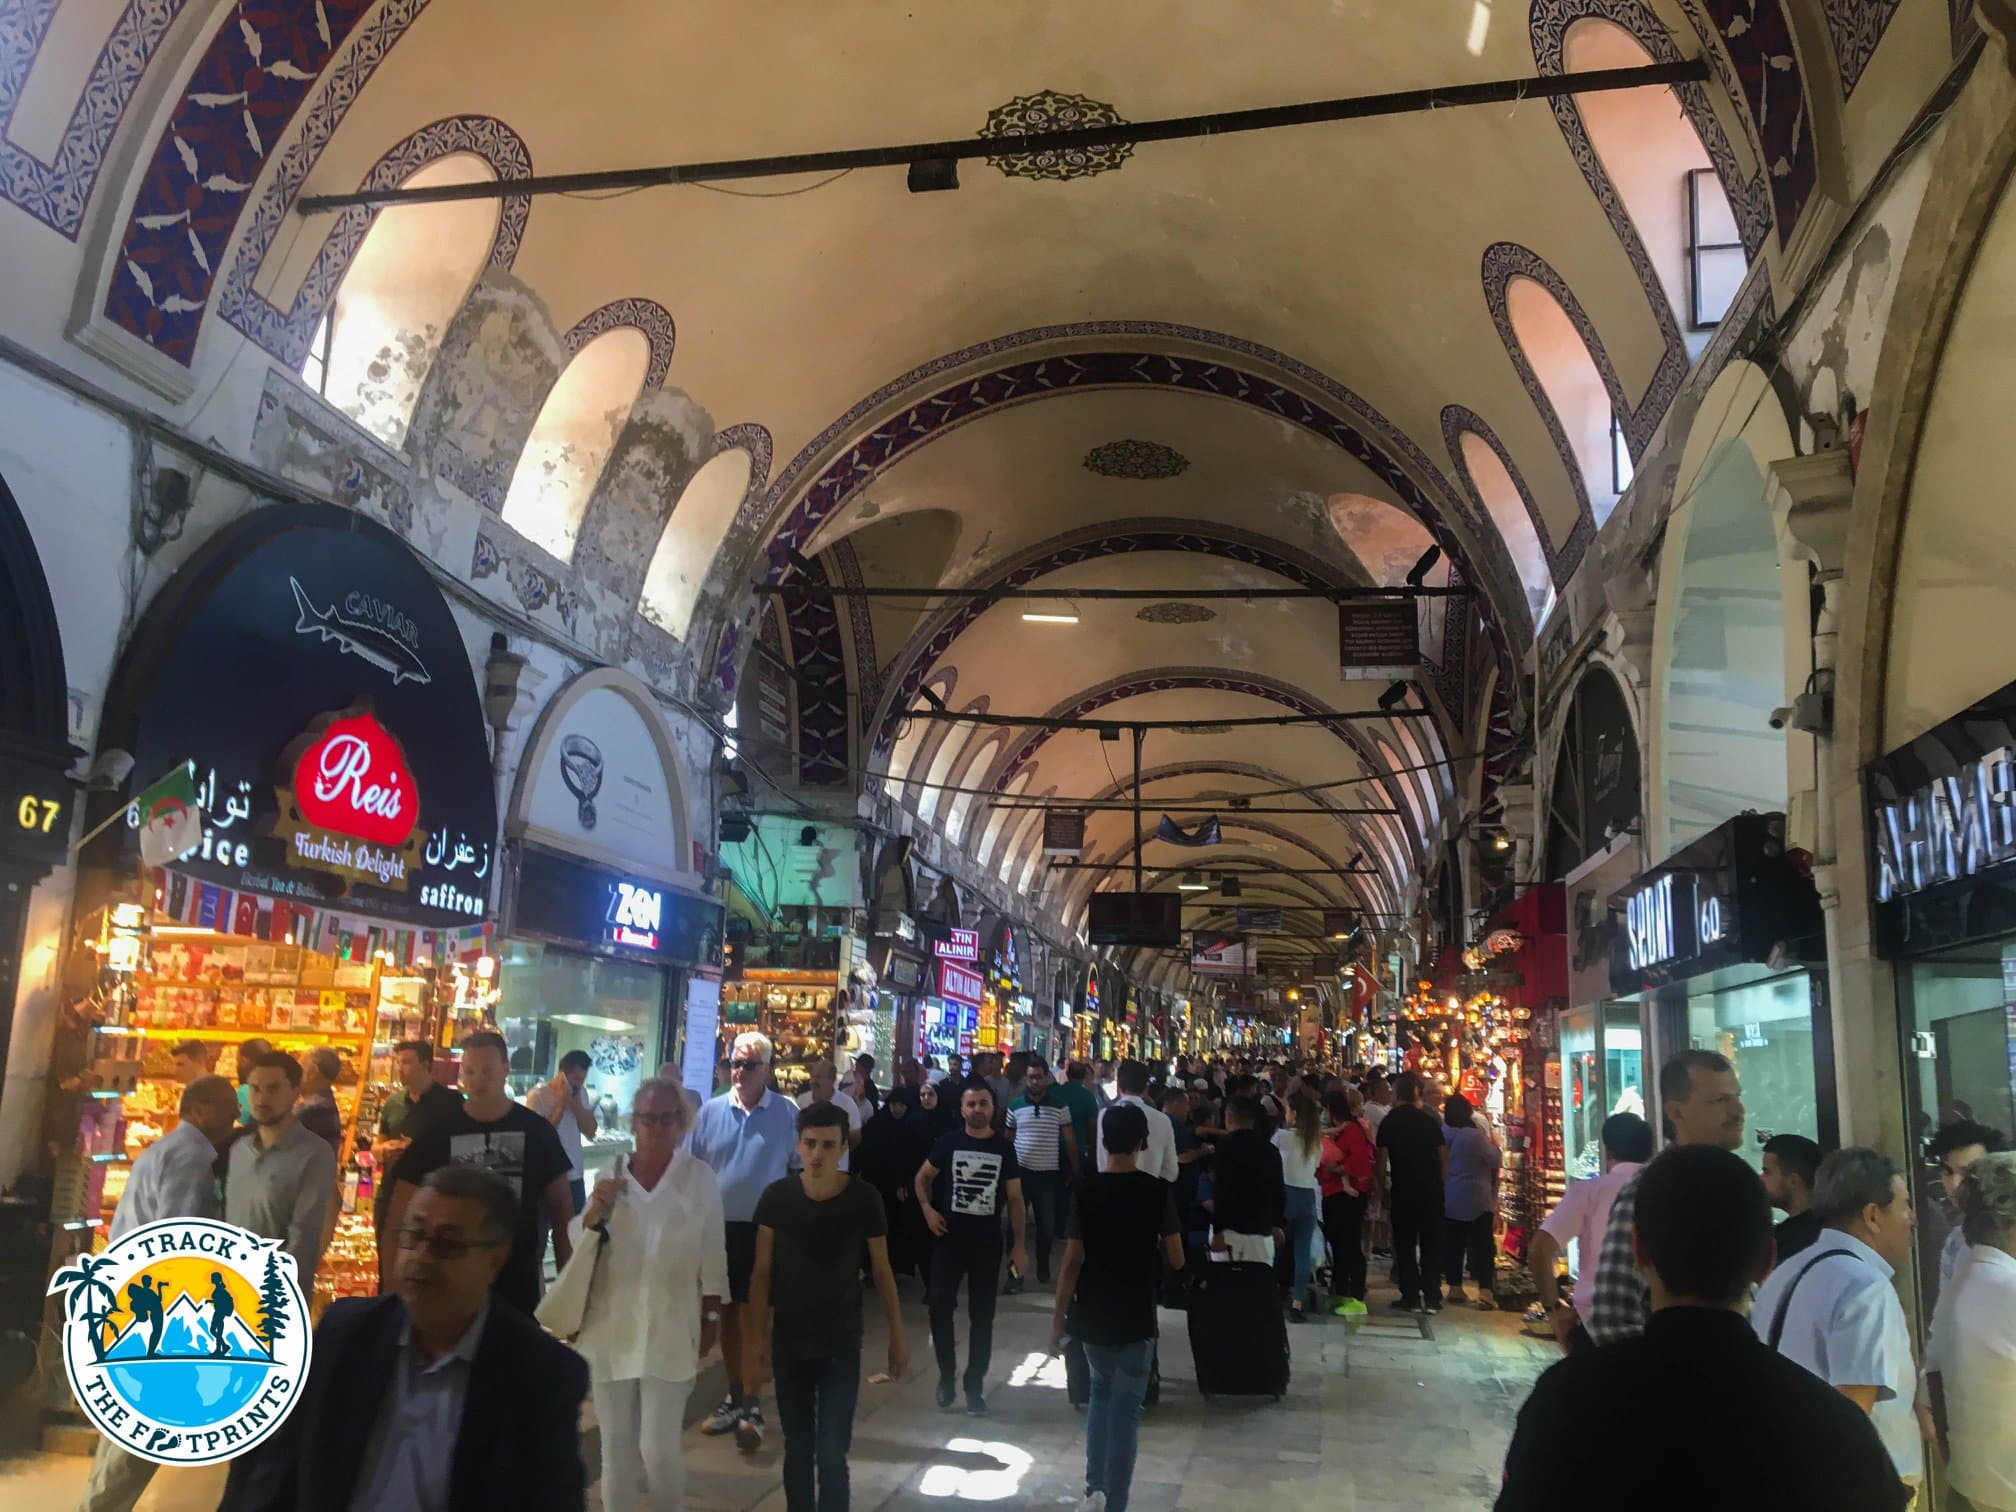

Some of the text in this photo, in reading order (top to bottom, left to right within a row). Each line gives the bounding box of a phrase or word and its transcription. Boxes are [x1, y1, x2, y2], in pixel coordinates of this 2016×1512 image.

[346, 590, 419, 649] CAVIAR
[314, 734, 401, 820] Reis
[19, 795, 59, 832] 67
[178, 828, 250, 868] ice
[295, 831, 405, 884] Turkish Delight
[426, 827, 488, 879] زعفران
[420, 884, 484, 916] saffron
[1701, 896, 1720, 943] 60
[938, 943, 974, 957] ALINIR
[951, 932, 973, 945] TIN
